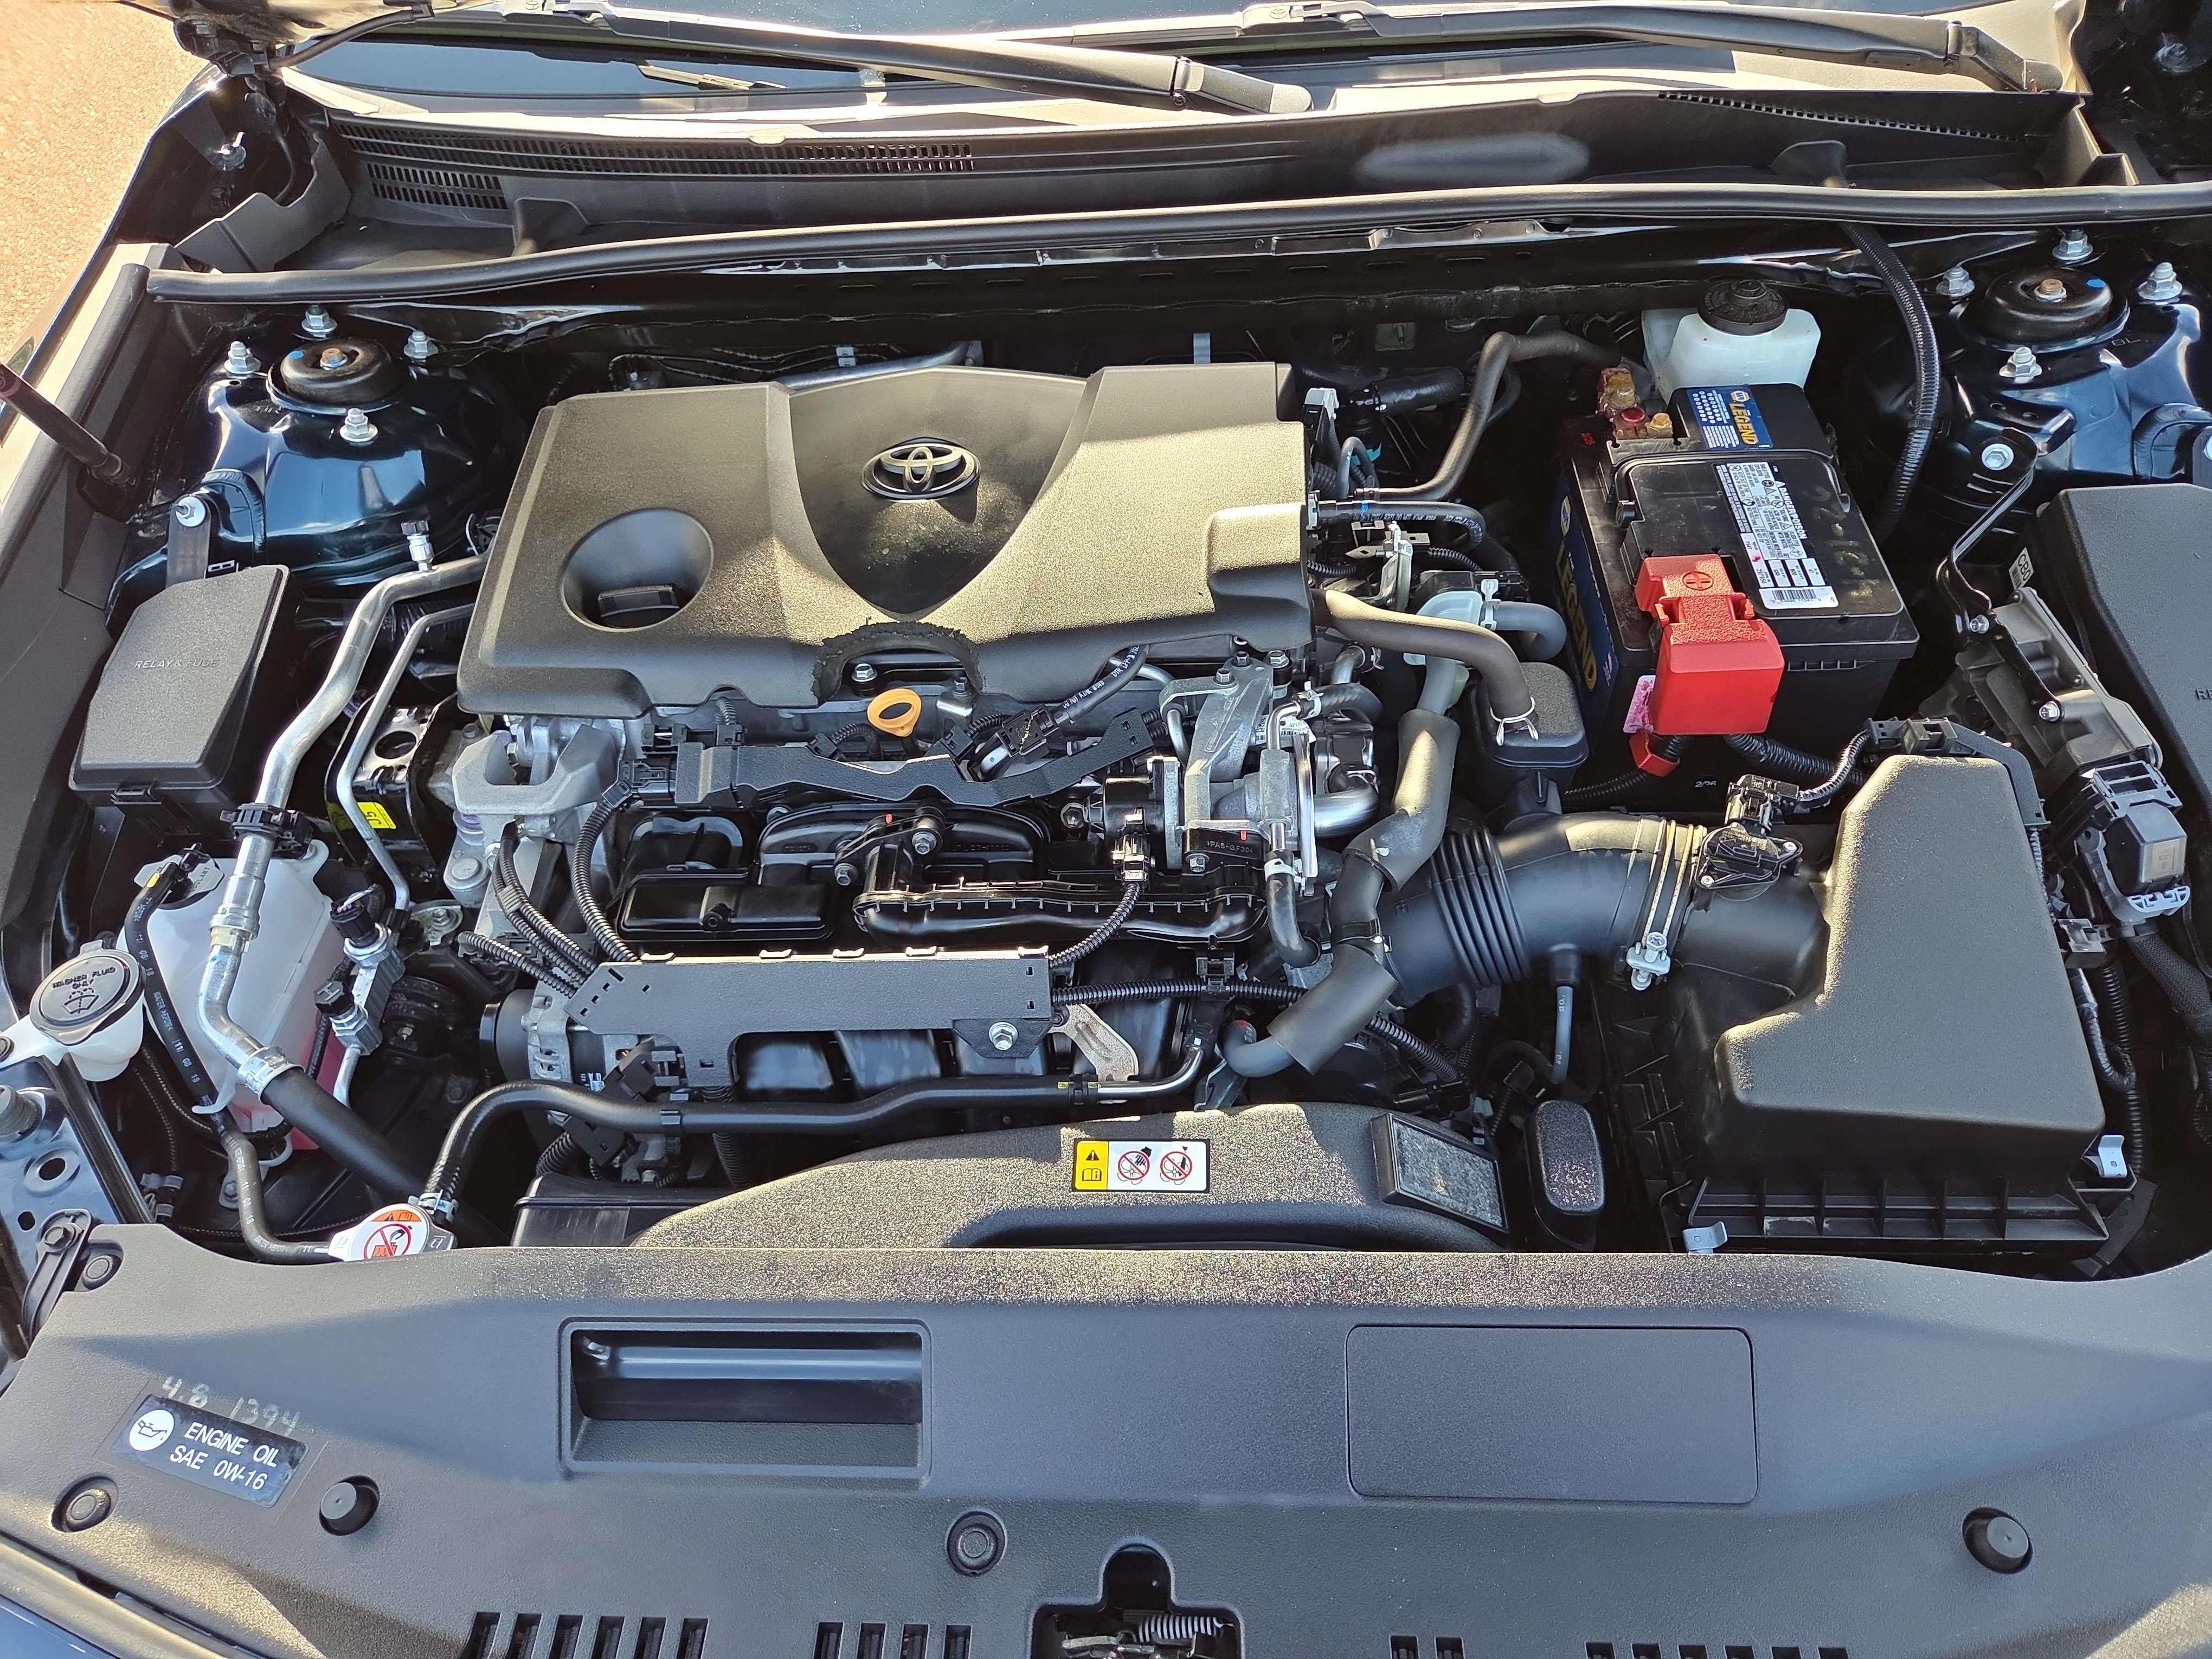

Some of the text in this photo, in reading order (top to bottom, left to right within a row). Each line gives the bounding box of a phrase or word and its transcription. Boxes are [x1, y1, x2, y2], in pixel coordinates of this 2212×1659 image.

[1729, 403, 1759, 445] LEGEND
[1778, 487, 1807, 538] DANGER/POISON
[133, 659, 174, 670] RELAY
[185, 659, 220, 668] FUSE
[52, 966, 116, 989] WASHER FLUID
[72, 979, 94, 989] ONLY
[317, 981, 340, 1001] H
[184, 1422, 280, 1468] ENGINE OIL
[169, 1446, 269, 1490] SAE 0W-16
